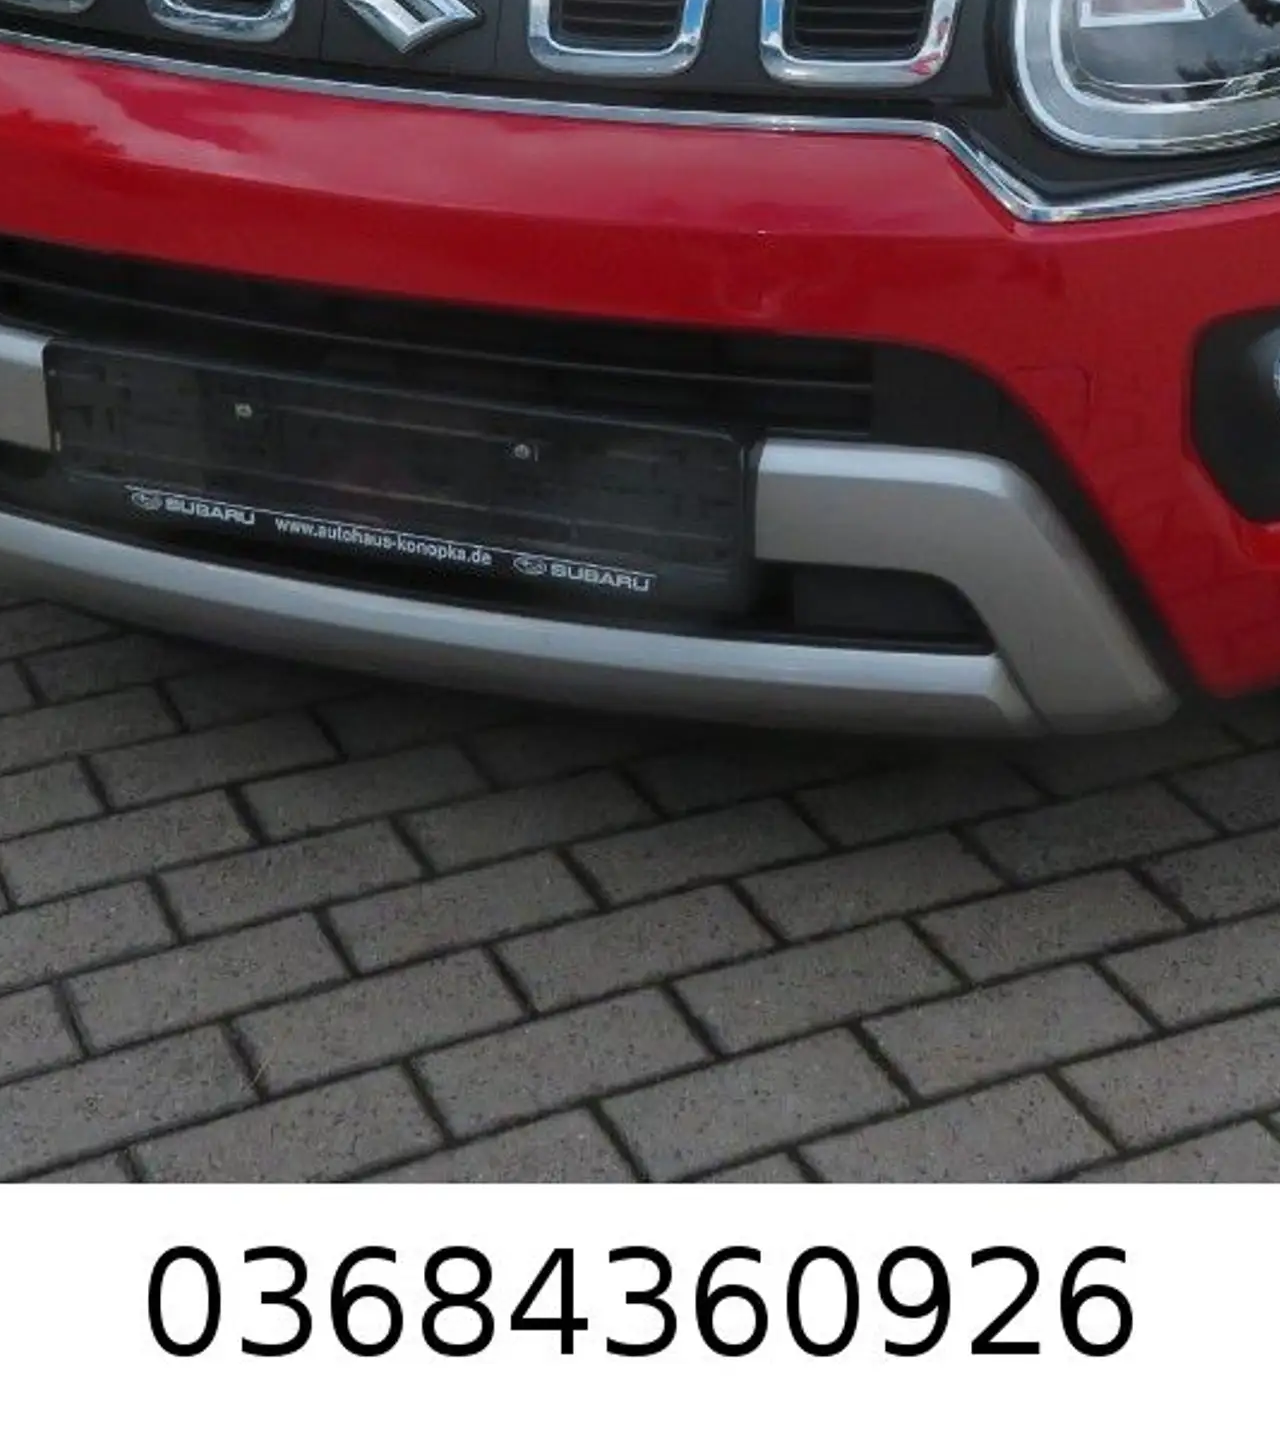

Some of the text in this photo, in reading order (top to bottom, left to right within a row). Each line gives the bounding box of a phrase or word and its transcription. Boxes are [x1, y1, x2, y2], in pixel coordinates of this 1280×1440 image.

[165, 497, 650, 592] SUBARU www.autohaus-konopka.de SUBARU
